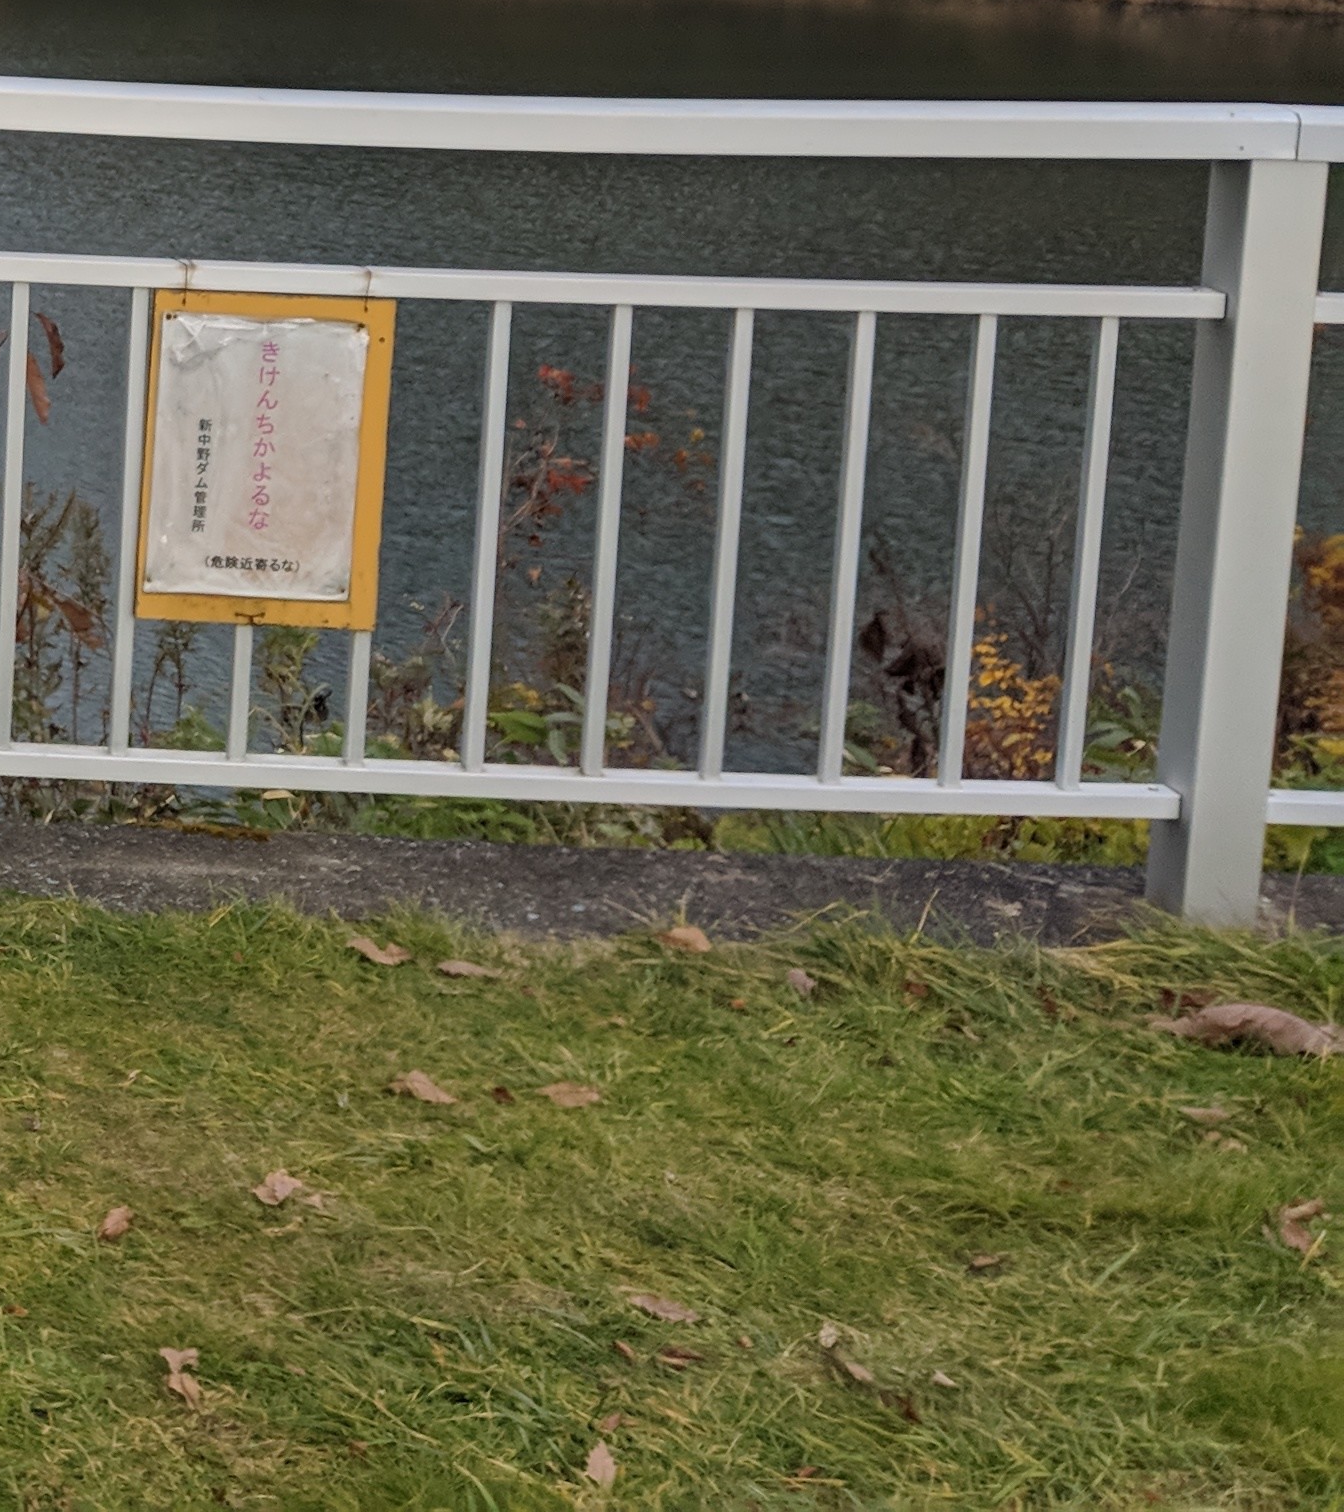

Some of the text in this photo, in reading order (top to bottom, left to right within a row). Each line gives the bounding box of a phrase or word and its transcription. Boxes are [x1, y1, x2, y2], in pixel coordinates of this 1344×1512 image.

[191, 418, 213, 533] 新中野ダム管理所
[248, 341, 280, 531] きけんちかよるな
